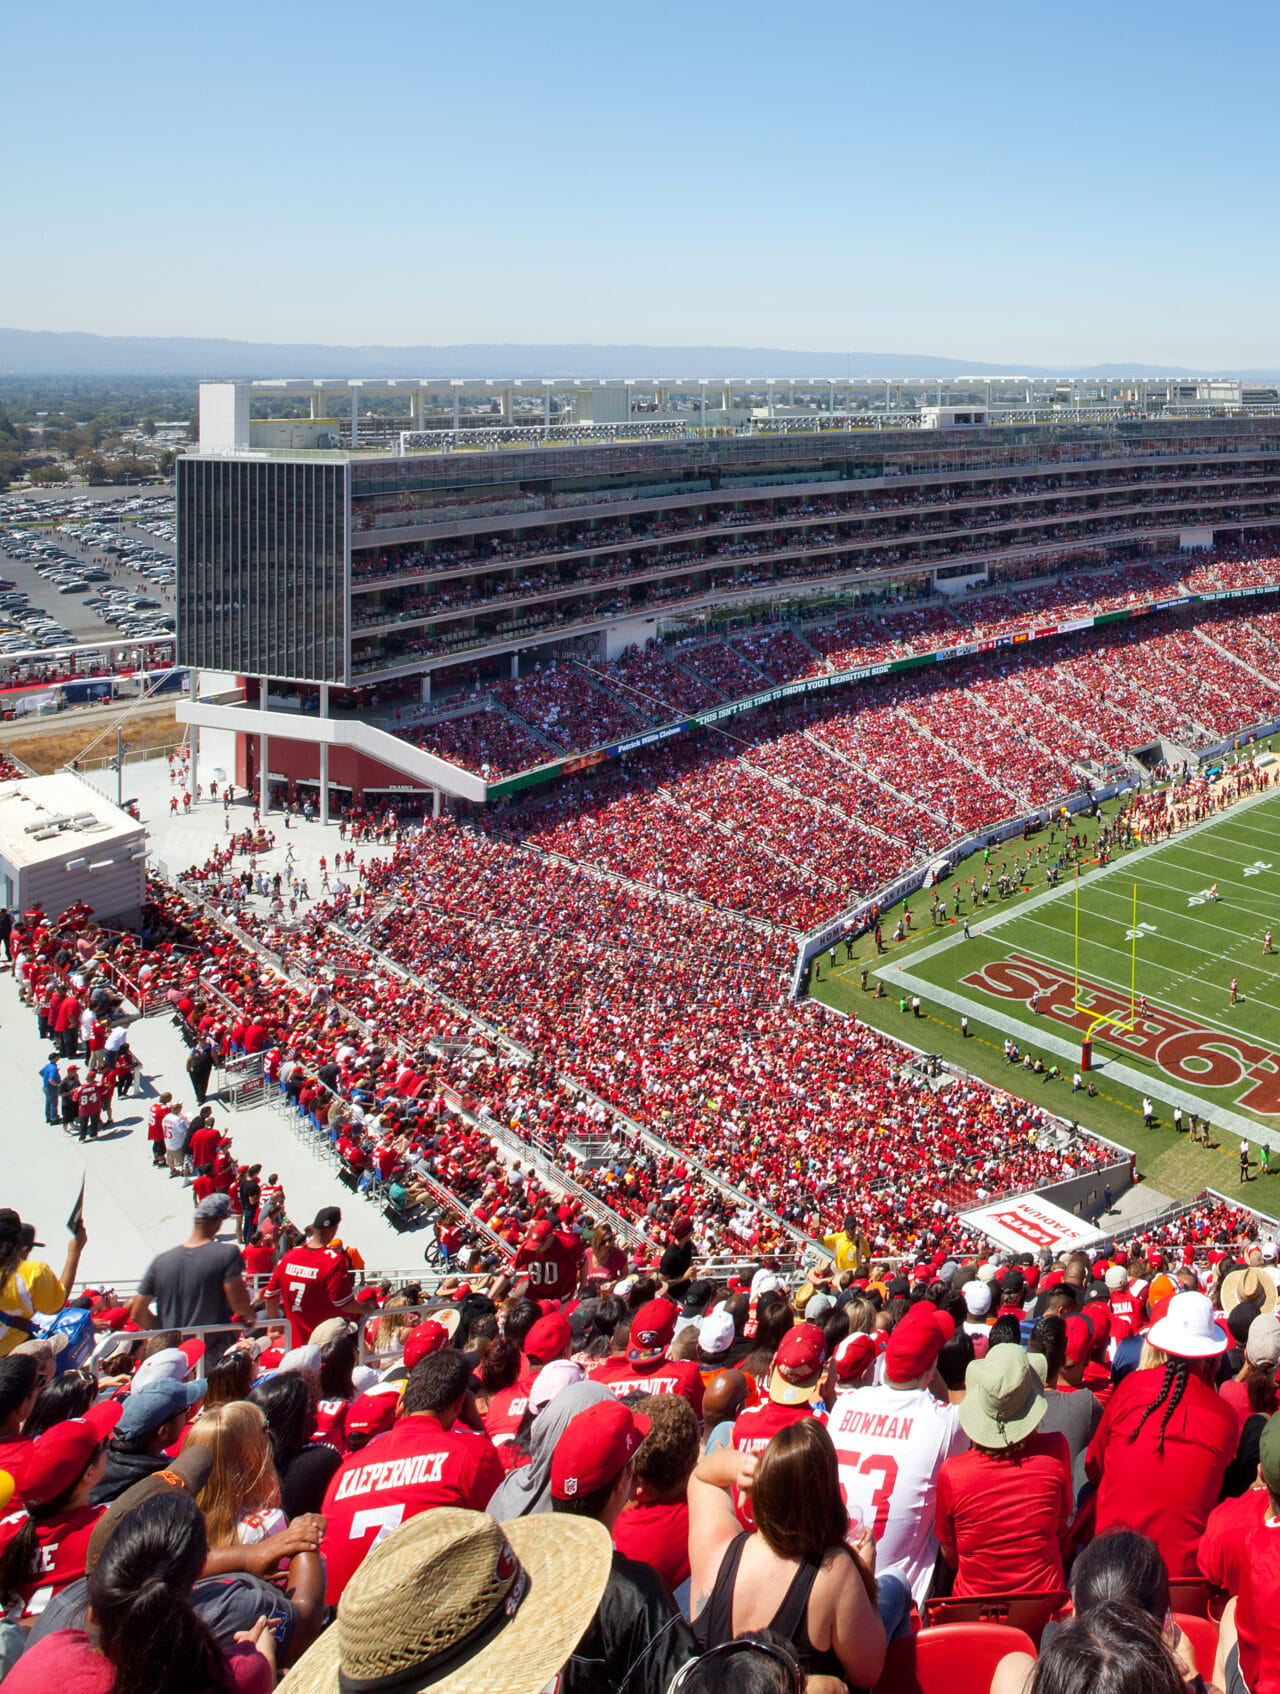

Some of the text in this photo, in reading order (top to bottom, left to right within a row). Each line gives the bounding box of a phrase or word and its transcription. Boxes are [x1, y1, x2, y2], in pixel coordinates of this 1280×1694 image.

[719, 705, 737, 718] ISN'T
[739, 700, 752, 711] THE
[754, 694, 771, 706] TIME
[772, 690, 781, 699] TO
[782, 684, 806, 696] SHOW
[807, 679, 829, 690] YOUR
[830, 669, 870, 684] SENSITIVE
[80, 1092, 98, 1106] 84
[1017, 1203, 1081, 1239] STADIUM
[289, 1281, 306, 1312] 7
[839, 1410, 914, 1440] BOWMAN
[334, 1452, 450, 1501] KAEPERNICK
